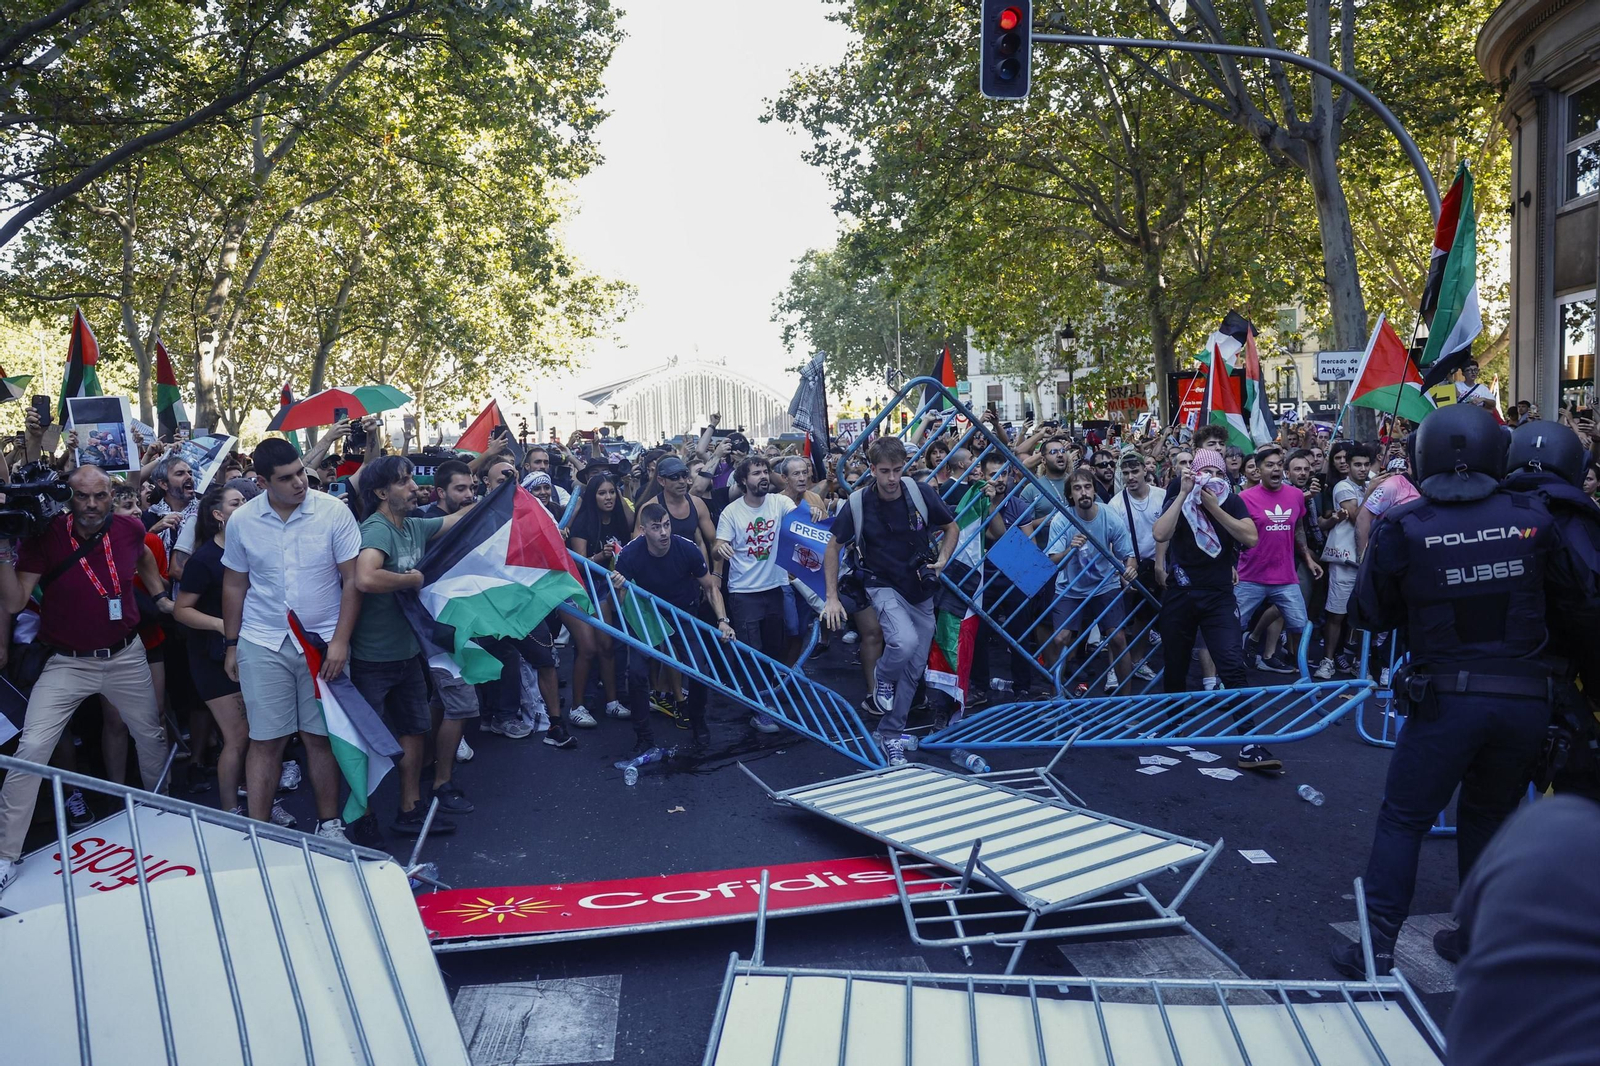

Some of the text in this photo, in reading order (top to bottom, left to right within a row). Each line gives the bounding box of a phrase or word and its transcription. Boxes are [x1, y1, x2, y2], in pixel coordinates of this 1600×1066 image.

[1321, 366, 1359, 375] Antó Ma
[1107, 396, 1148, 411] MIERDA
[1110, 410, 1126, 421] PA
[838, 421, 858, 432] FREE
[415, 466, 438, 475] LES
[745, 520, 775, 534] ARO
[794, 523, 833, 543] PRESS
[1265, 523, 1291, 531] adidas
[745, 532, 776, 546] ARO
[1424, 525, 1523, 549] POLICIA
[577, 868, 897, 910] Cofidis
